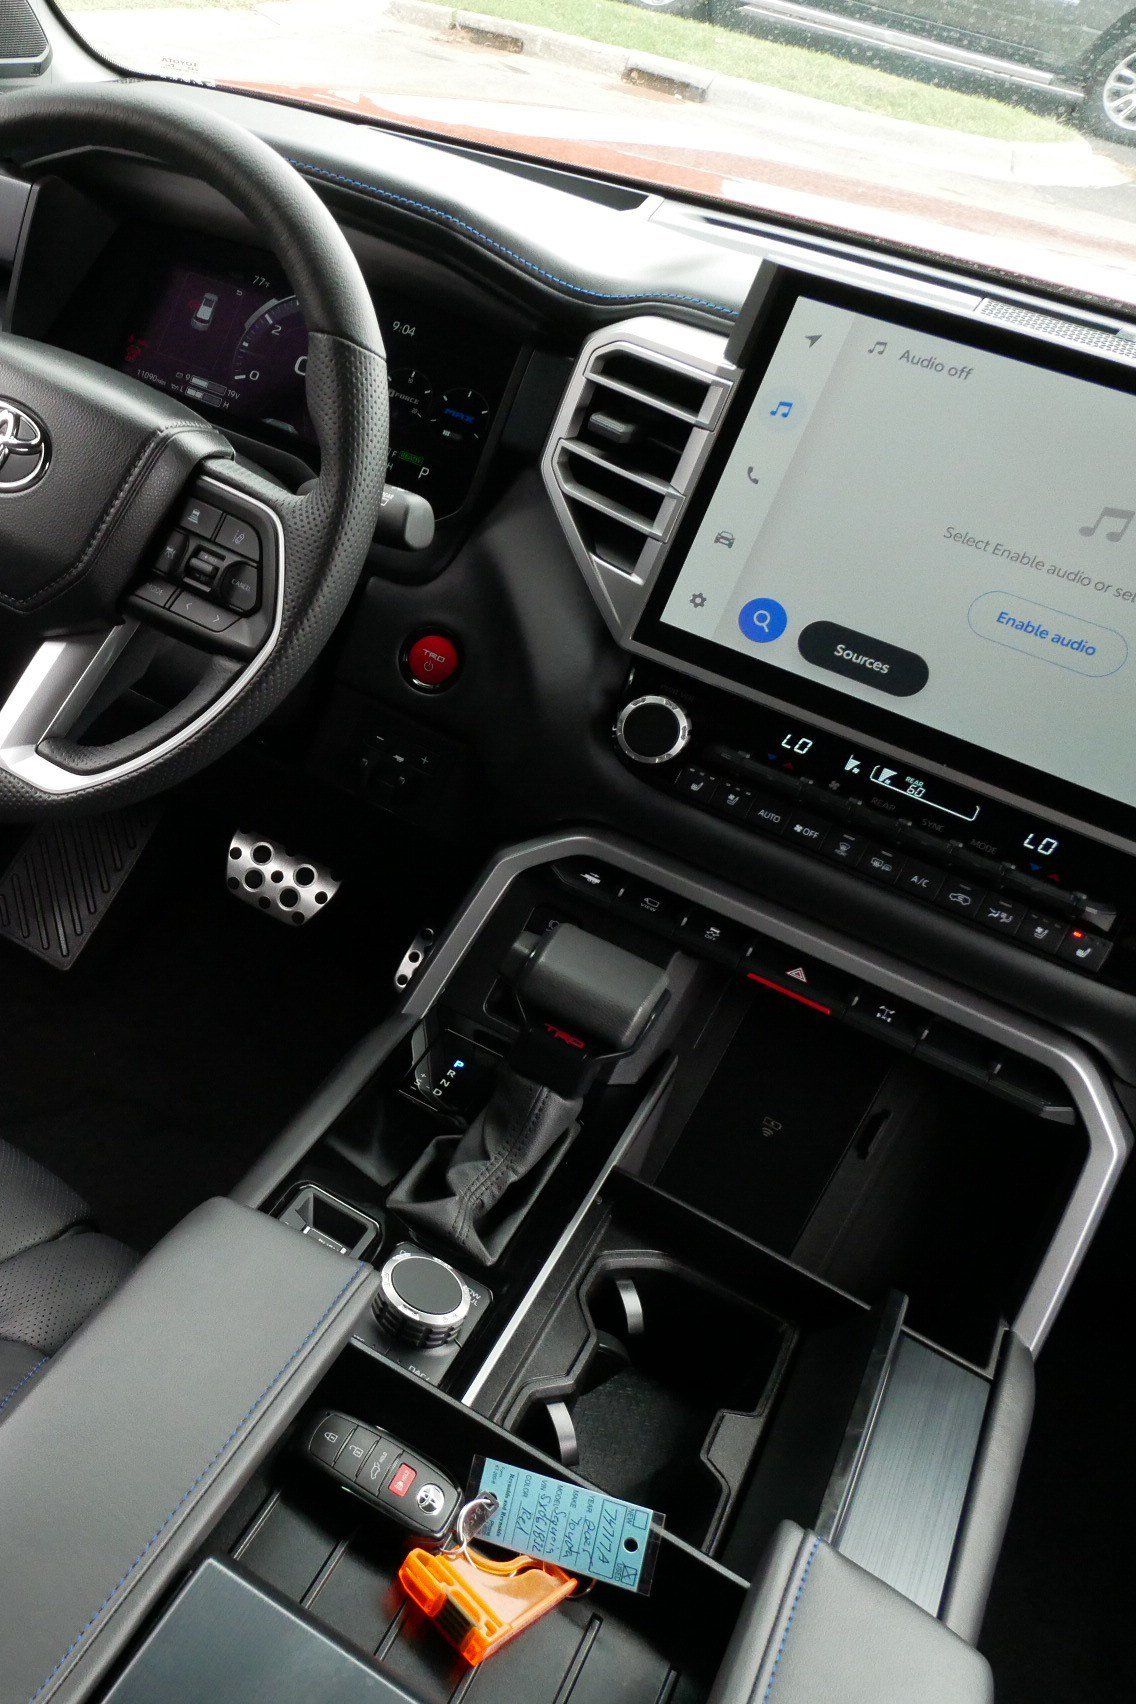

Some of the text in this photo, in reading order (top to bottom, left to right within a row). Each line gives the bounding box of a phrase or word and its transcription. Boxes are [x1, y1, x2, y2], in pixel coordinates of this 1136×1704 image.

[271, 325, 282, 336] 2
[392, 320, 416, 337] 9:04
[899, 350, 974, 380] Audio off
[249, 370, 259, 381] 0
[417, 466, 430, 479] P
[943, 526, 991, 552] Select
[992, 543, 1045, 571] Enable
[1046, 563, 1092, 587] audio
[1094, 581, 1113, 593] or
[996, 611, 1097, 656] Enable audio
[423, 648, 445, 663] TRD
[834, 644, 890, 674] Sources
[905, 775, 924, 787] REAR
[906, 784, 926, 798] 60
[758, 809, 781, 822] AUTO
[802, 827, 820, 839] OFF
[911, 875, 929, 888] A/C
[545, 1023, 585, 1049] TRD
[453, 1059, 464, 1068] P
[446, 1069, 456, 1078] R
[439, 1078, 450, 1088] N
[432, 1088, 442, 1096] D
[522, 1474, 532, 1498] COLOR
[540, 1480, 548, 1491] VIN
[569, 1490, 579, 1509] MAKE
[587, 1495, 595, 1513] YEAR
[515, 1506, 532, 1536] Red
[625, 1507, 635, 1525] NEW
